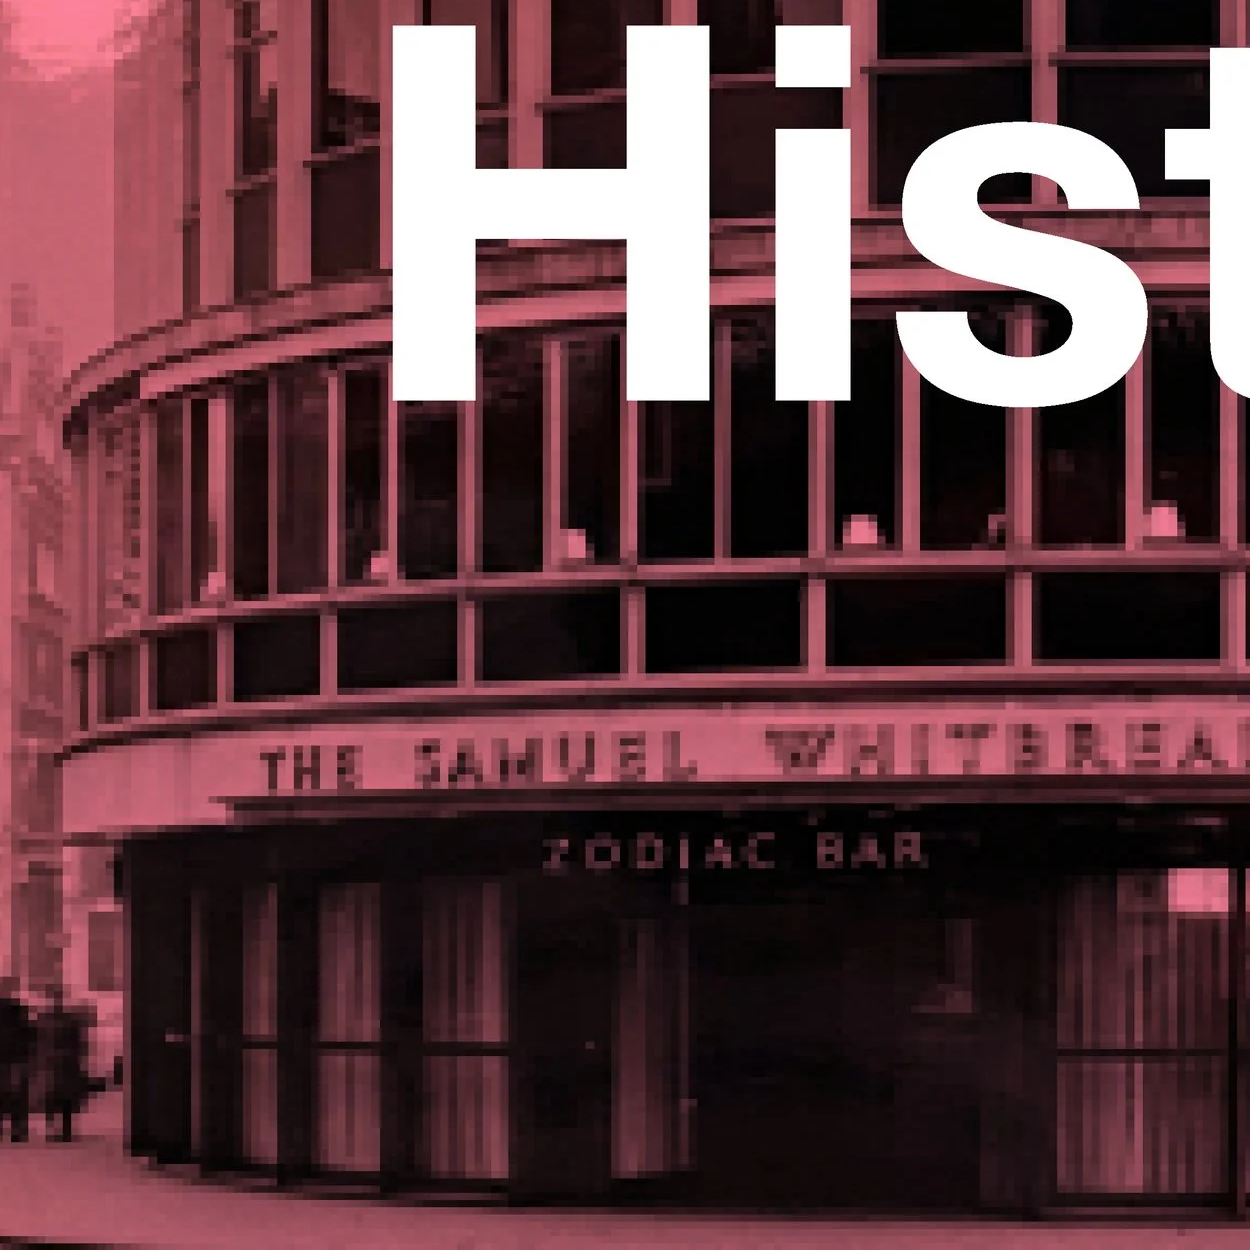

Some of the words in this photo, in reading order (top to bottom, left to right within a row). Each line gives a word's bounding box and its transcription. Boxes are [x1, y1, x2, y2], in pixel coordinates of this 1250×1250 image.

[260, 745, 363, 790] THE
[414, 731, 699, 789] SAMUEL
[542, 831, 776, 872] ZODIAC
[816, 831, 929, 870] BAR
